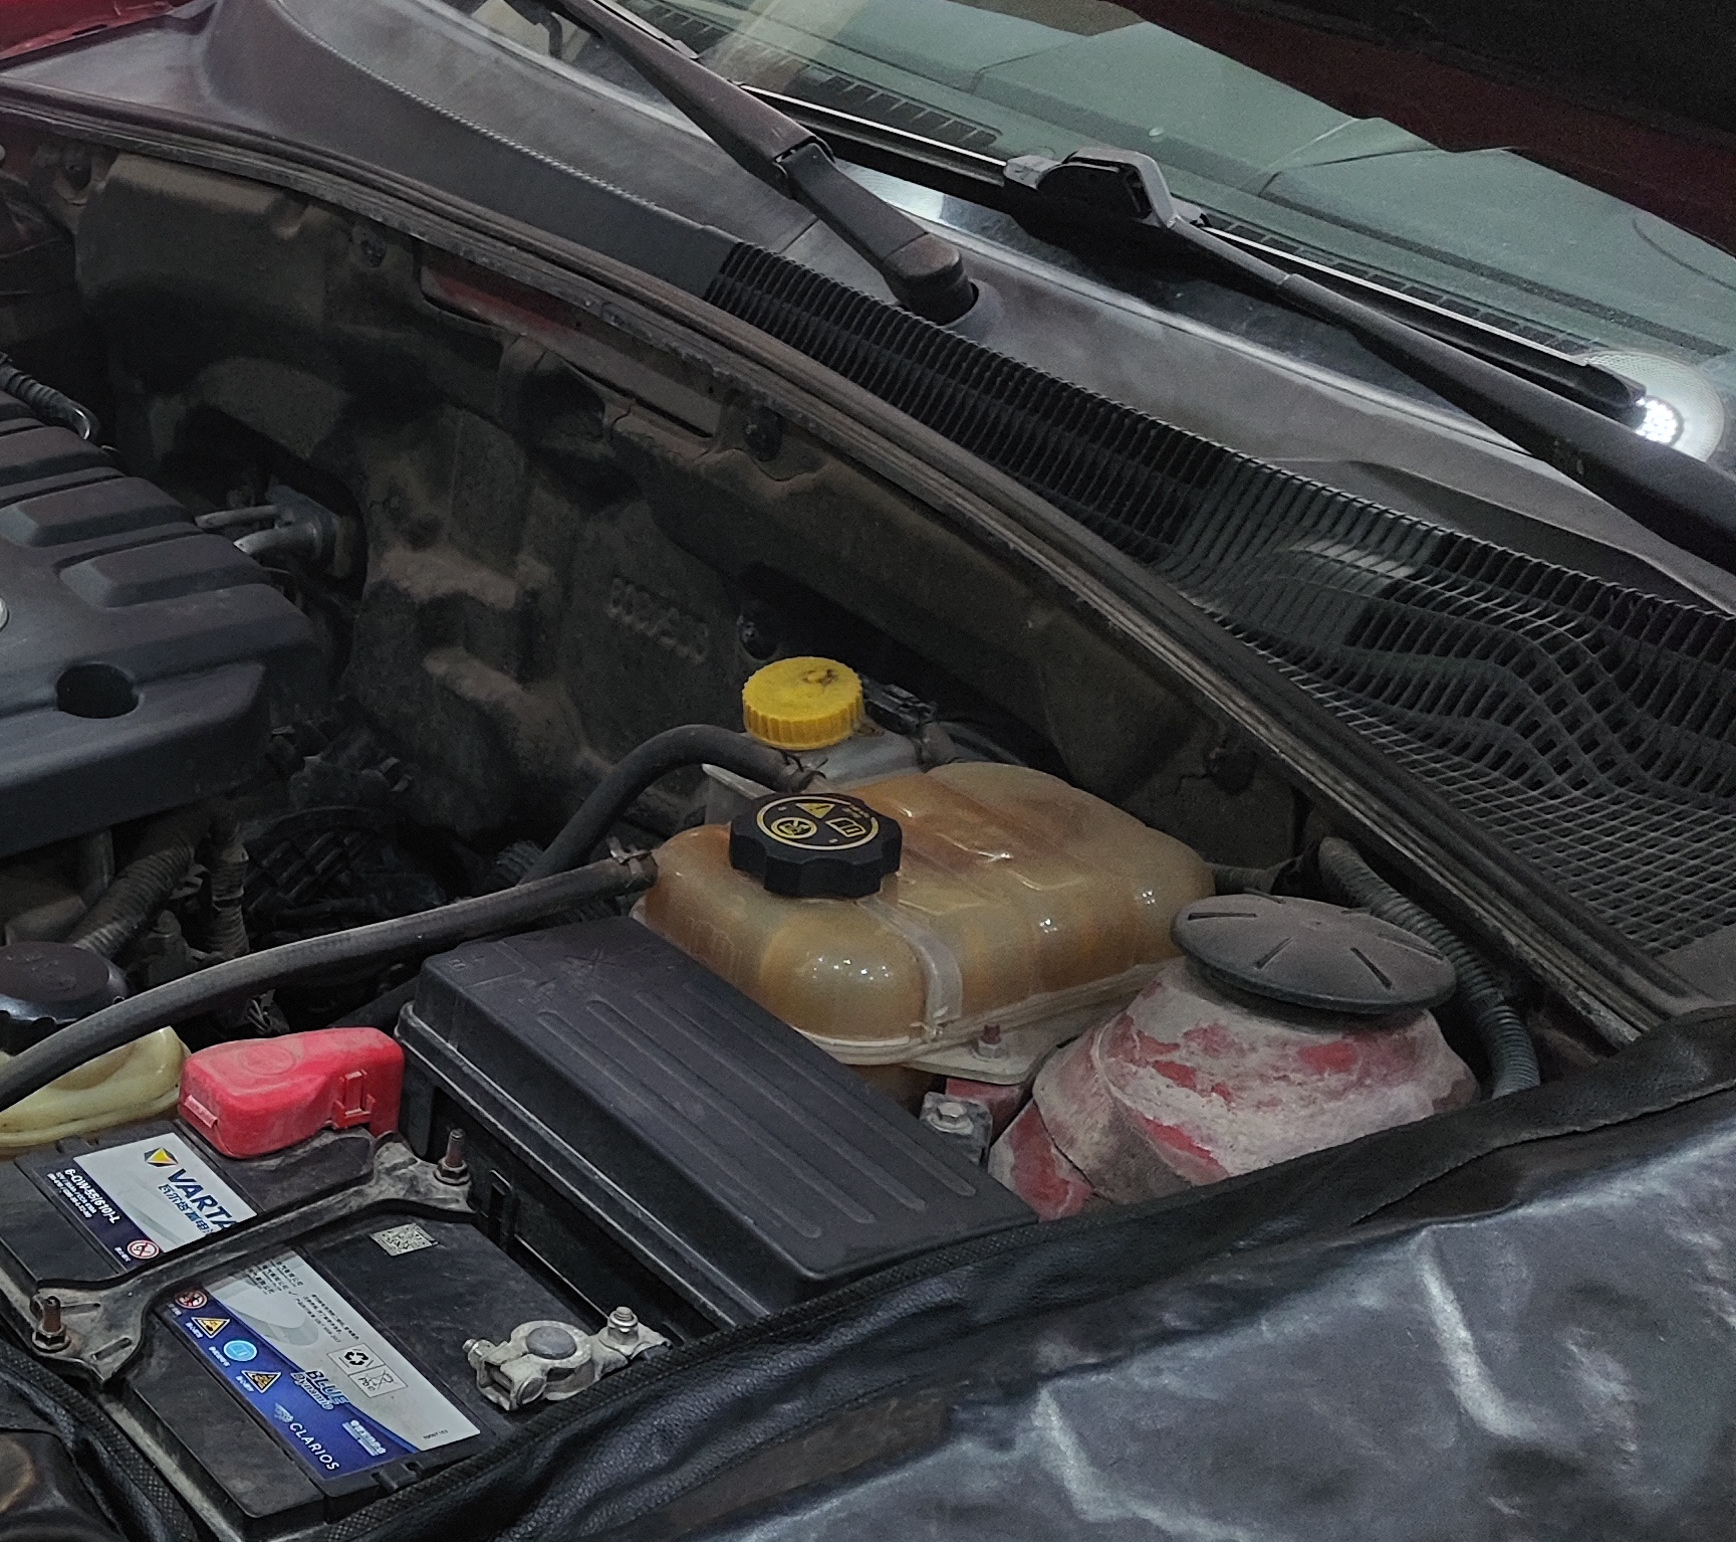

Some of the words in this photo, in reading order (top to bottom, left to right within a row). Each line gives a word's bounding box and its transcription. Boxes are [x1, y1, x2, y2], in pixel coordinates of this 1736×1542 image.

[167, 1167, 239, 1231] VARTA
[306, 1369, 351, 1405] BLUE
[289, 1421, 341, 1471] CLARIOS
